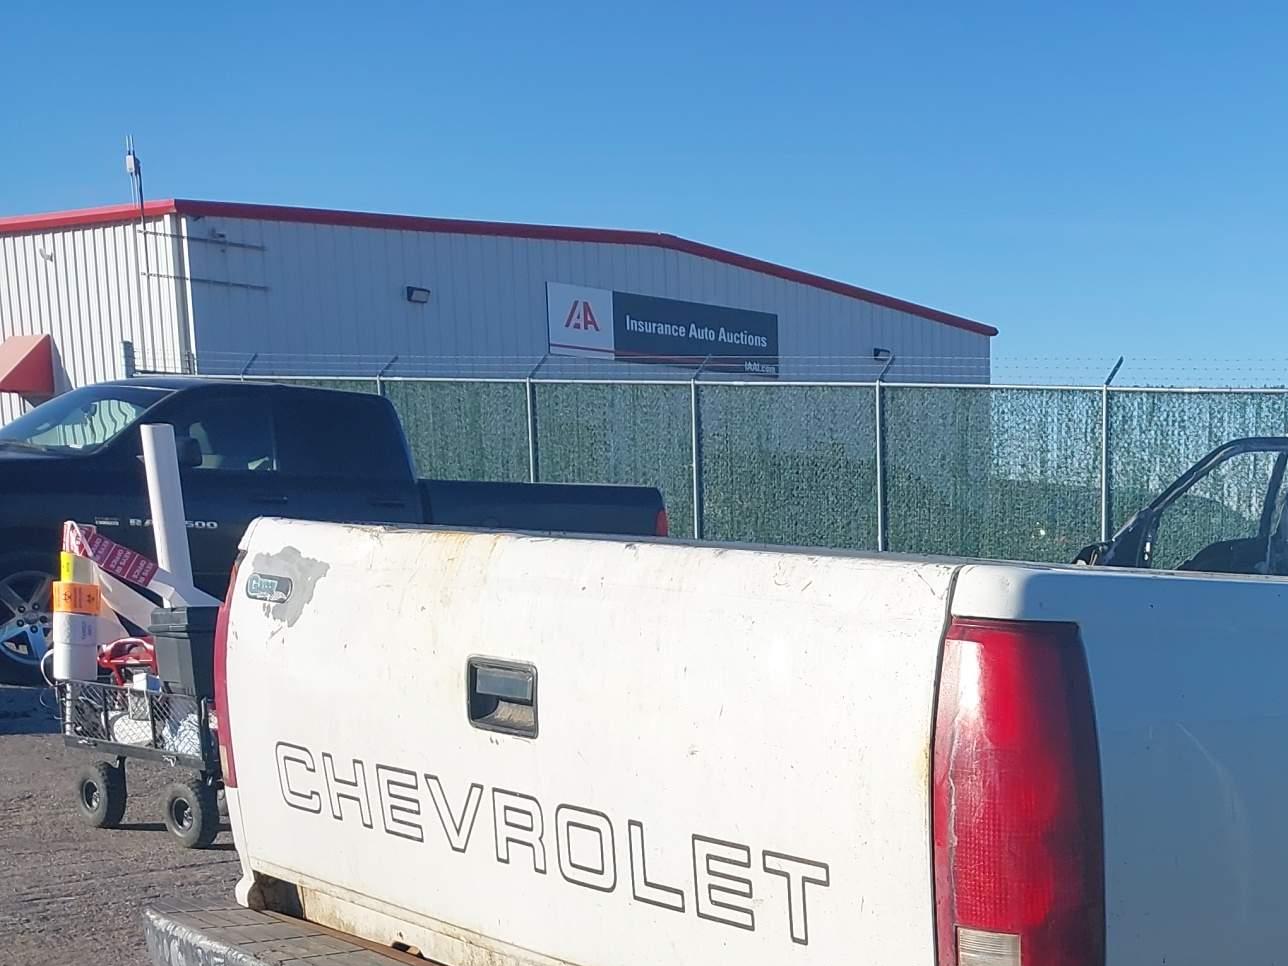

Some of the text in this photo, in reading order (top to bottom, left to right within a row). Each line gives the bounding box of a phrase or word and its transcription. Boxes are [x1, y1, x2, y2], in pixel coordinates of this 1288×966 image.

[625, 315, 768, 348] Insurance Auto Auctions
[275, 741, 830, 946] CHEVROLET
